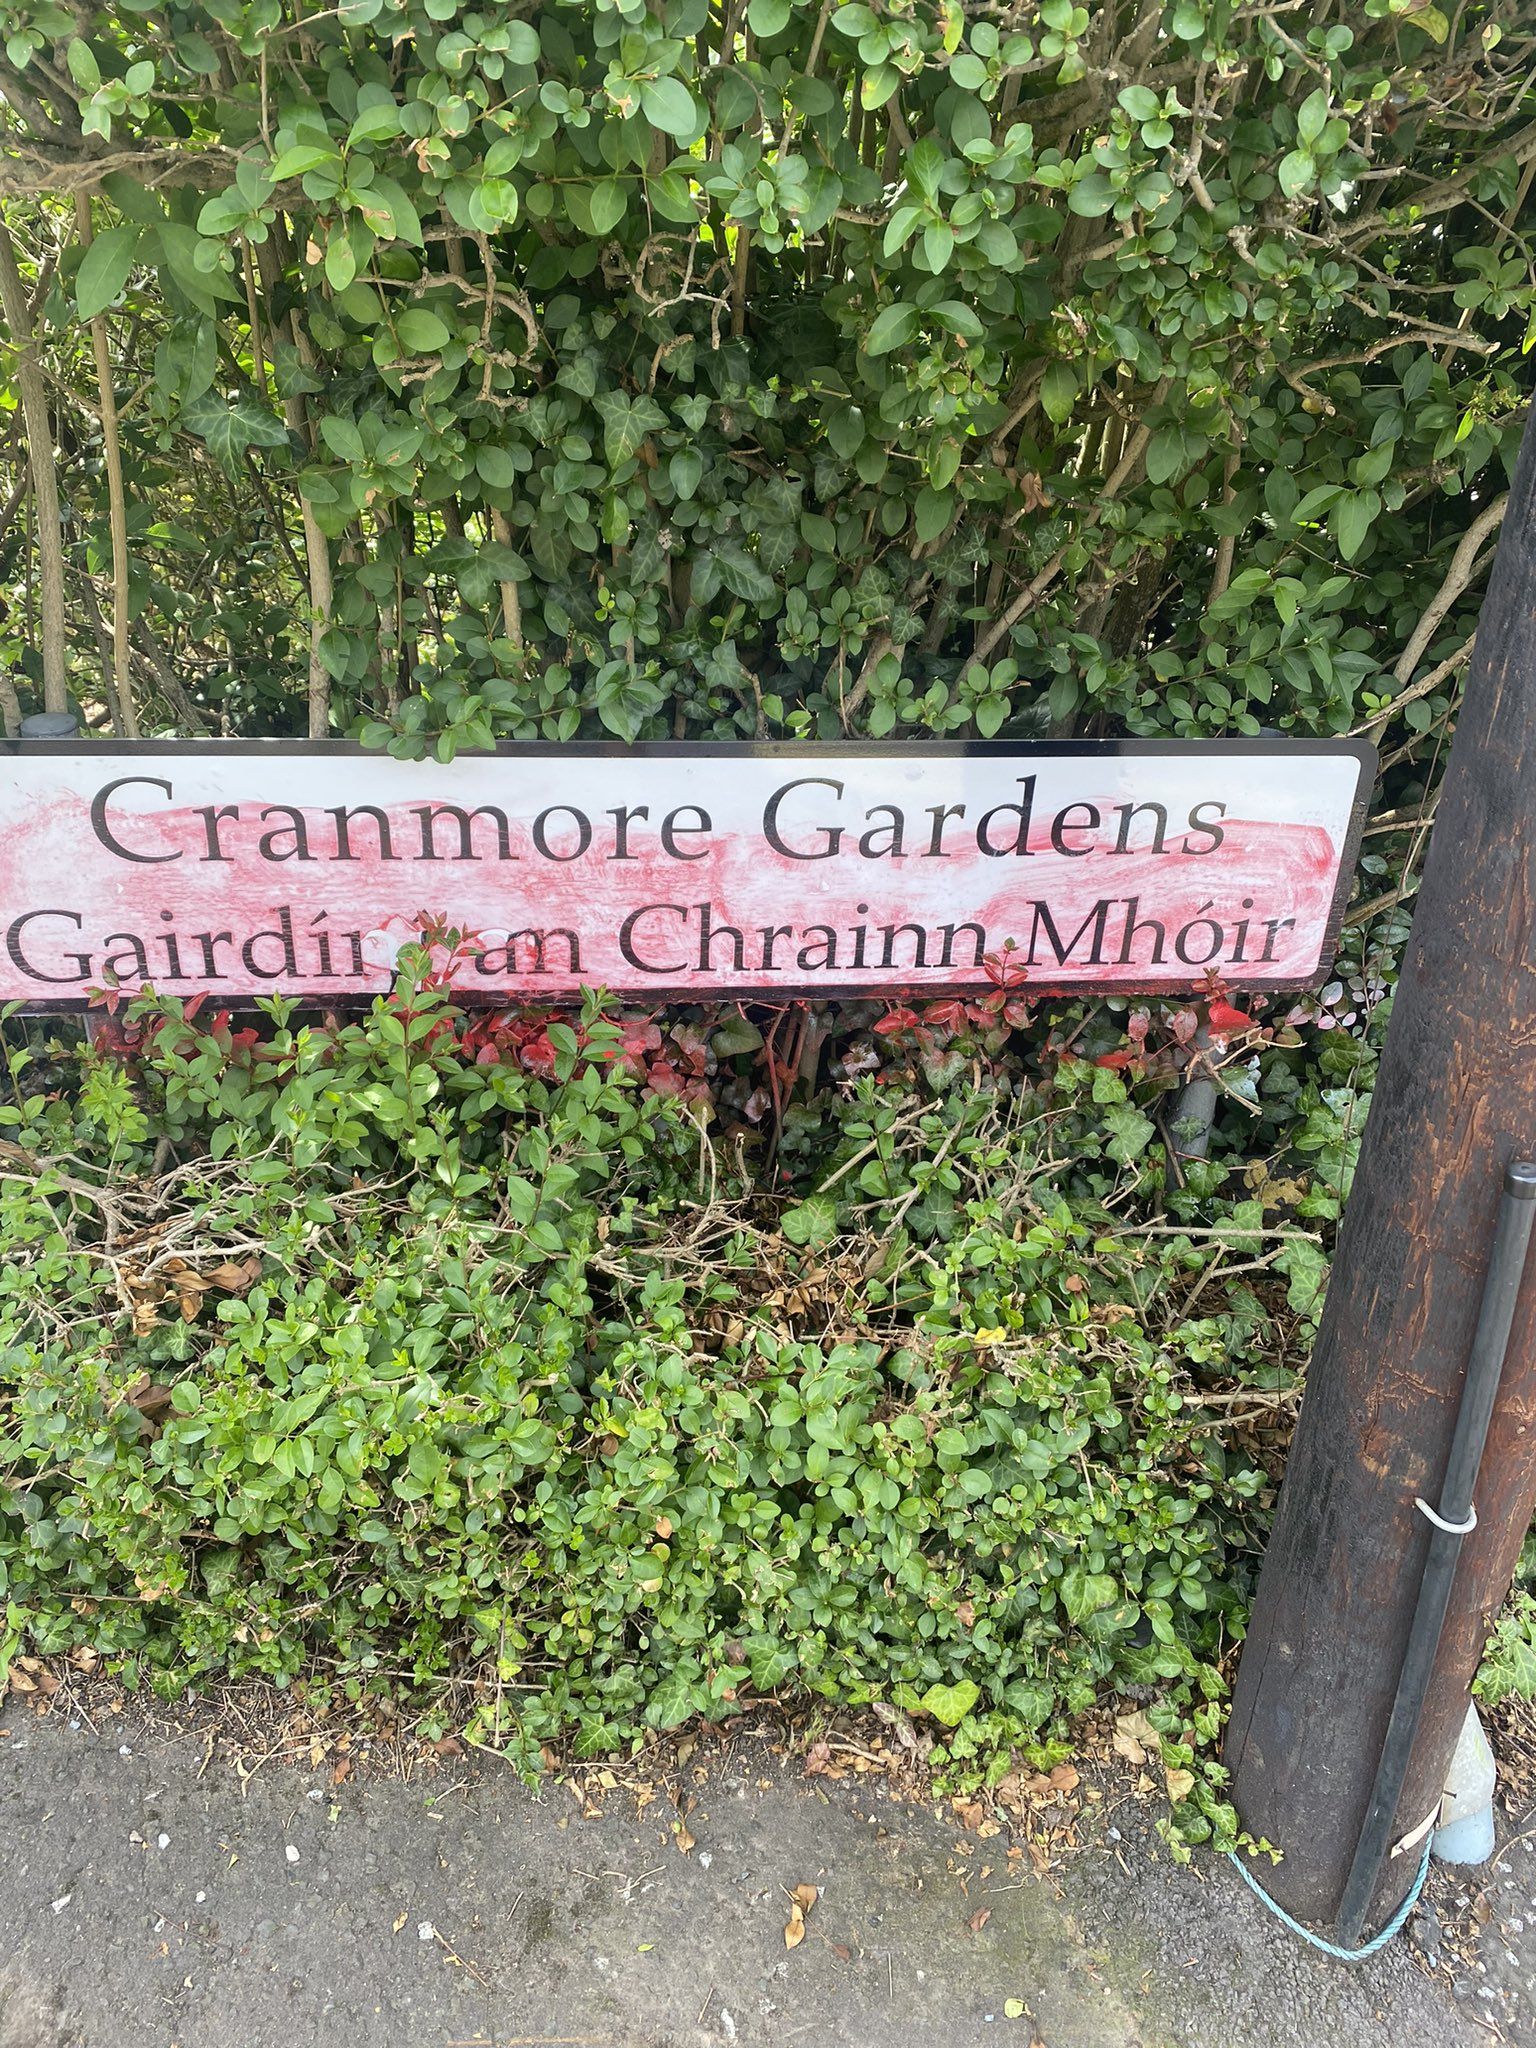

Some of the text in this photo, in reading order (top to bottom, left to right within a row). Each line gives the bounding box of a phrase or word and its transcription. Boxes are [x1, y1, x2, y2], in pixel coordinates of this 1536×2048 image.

[90, 774, 1227, 863] Cranmore Gardens
[474, 927, 589, 976] an
[618, 901, 986, 974] Chrainn
[1017, 895, 1297, 967] Mhóir
